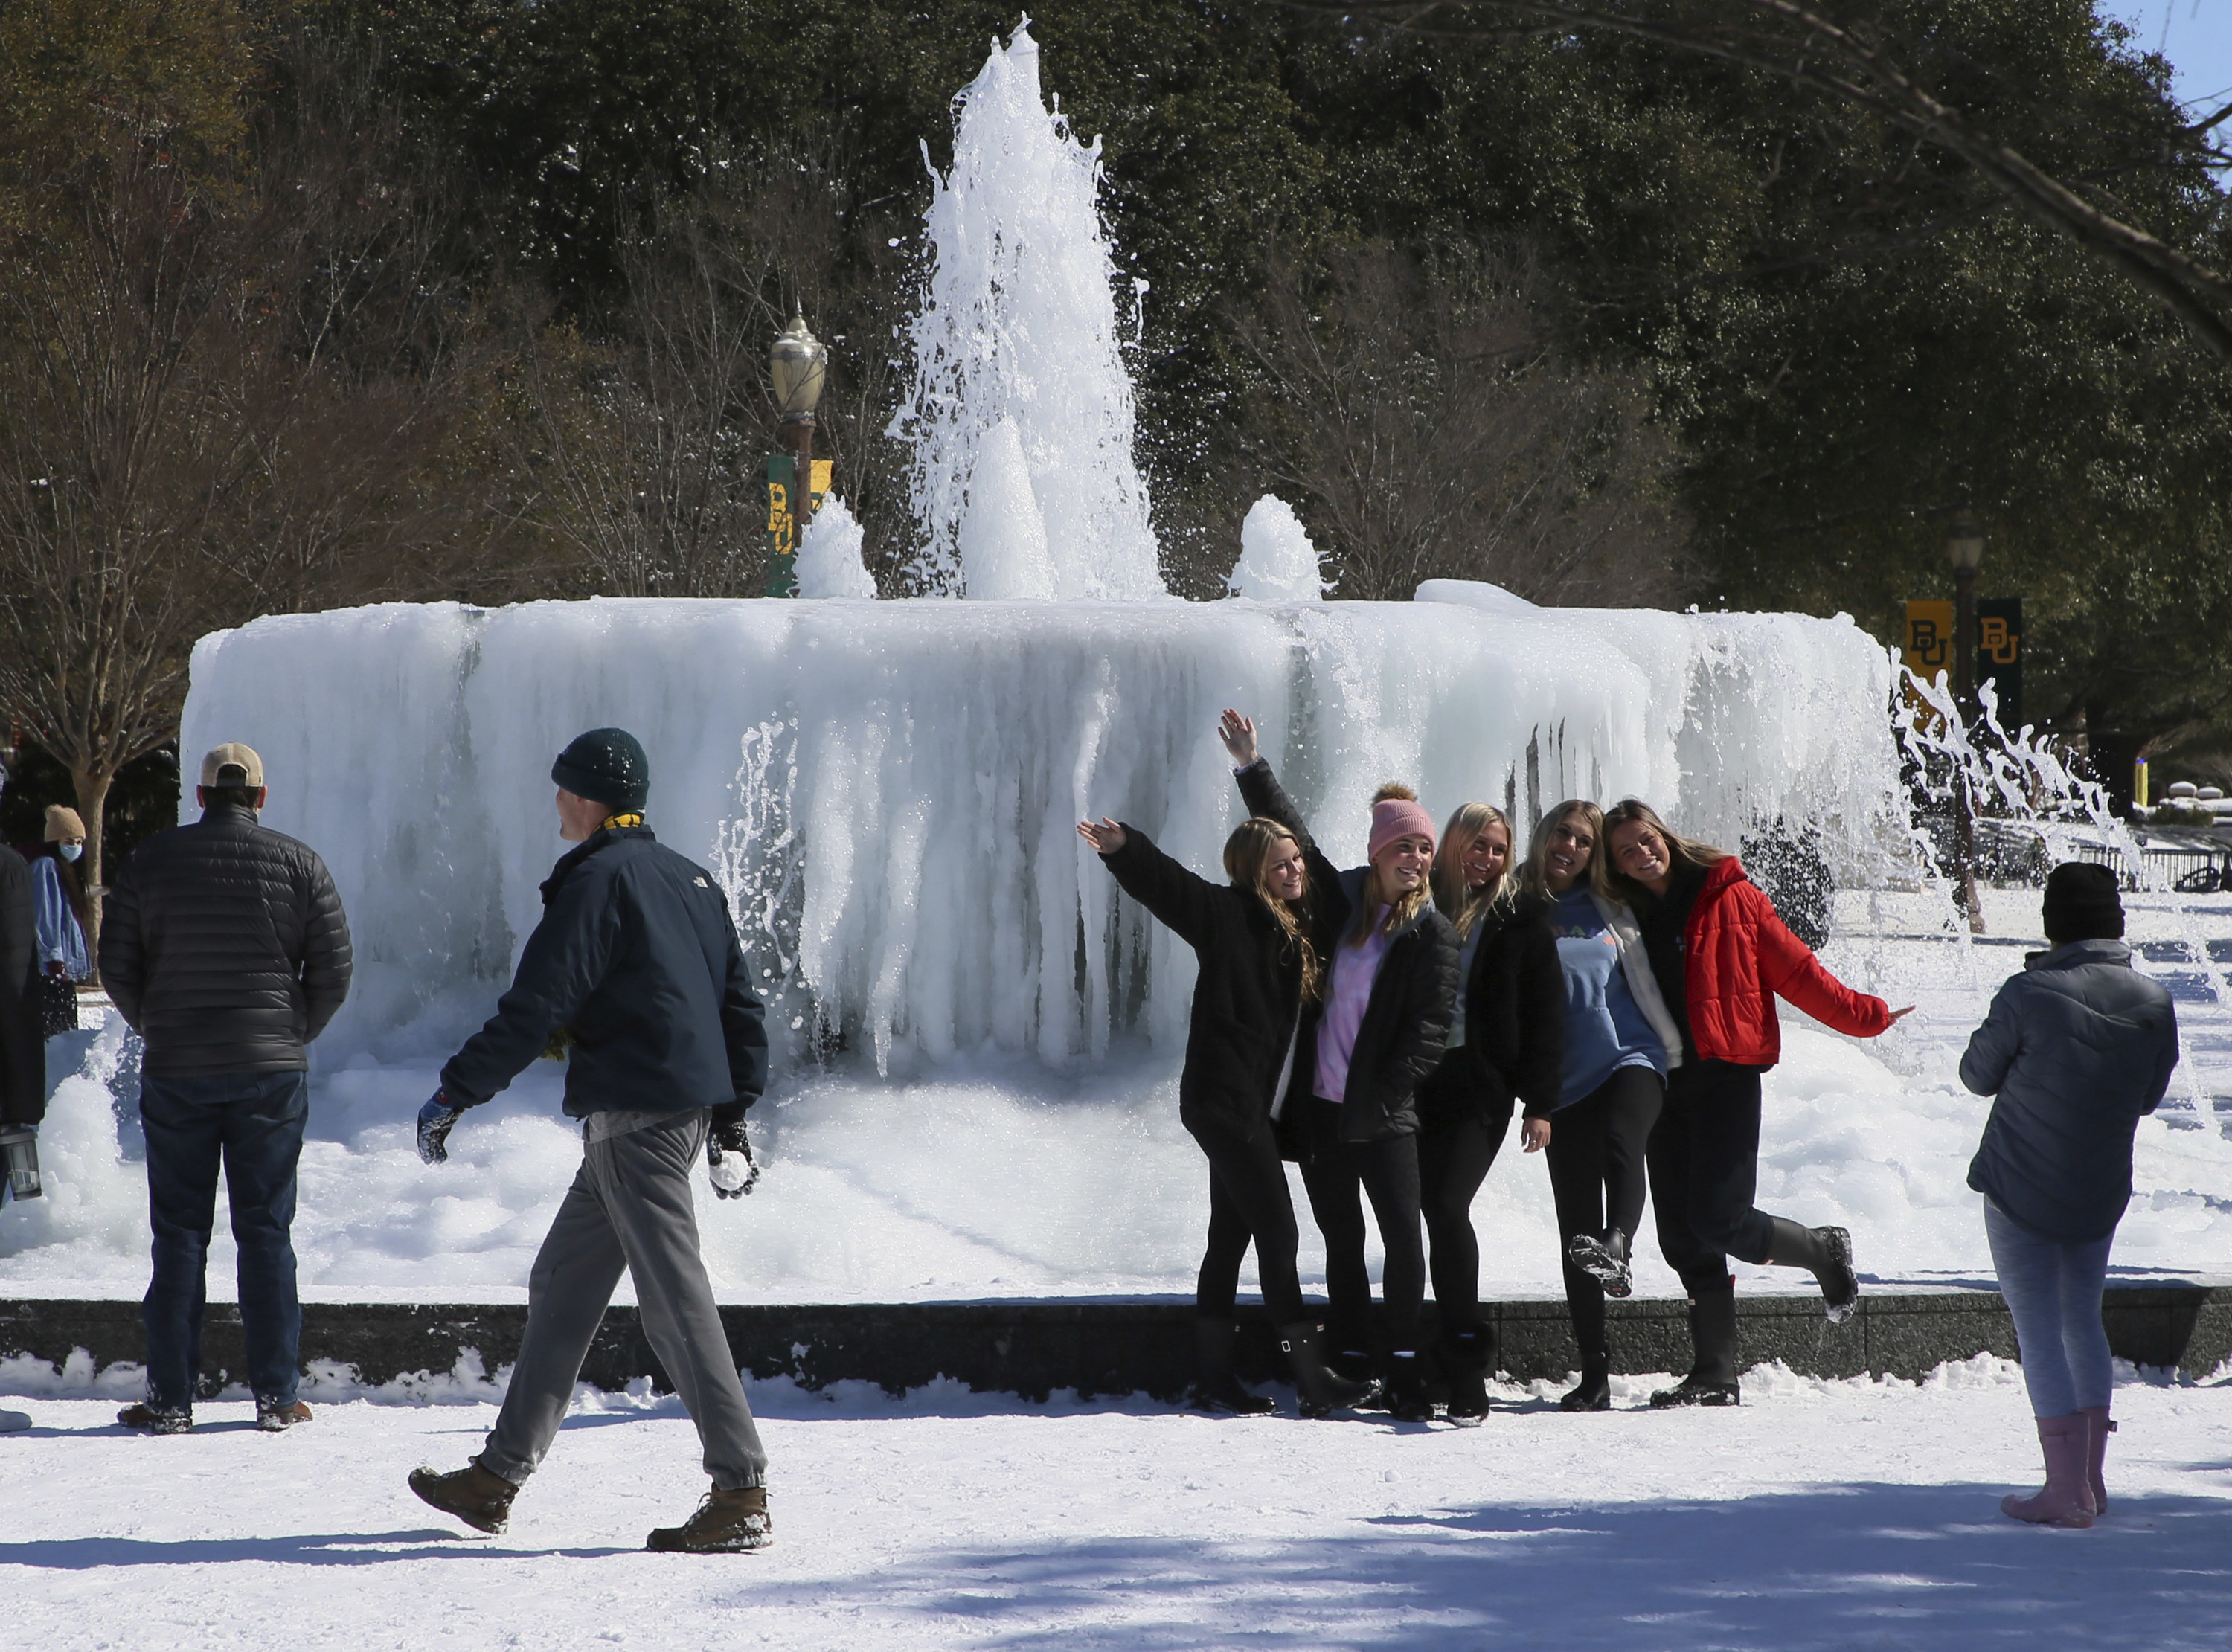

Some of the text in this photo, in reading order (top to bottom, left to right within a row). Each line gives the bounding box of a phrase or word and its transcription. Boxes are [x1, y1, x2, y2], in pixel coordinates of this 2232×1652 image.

[768, 483, 793, 554] BU
[1911, 620, 1948, 665] BU
[1981, 617, 2018, 664] BU
